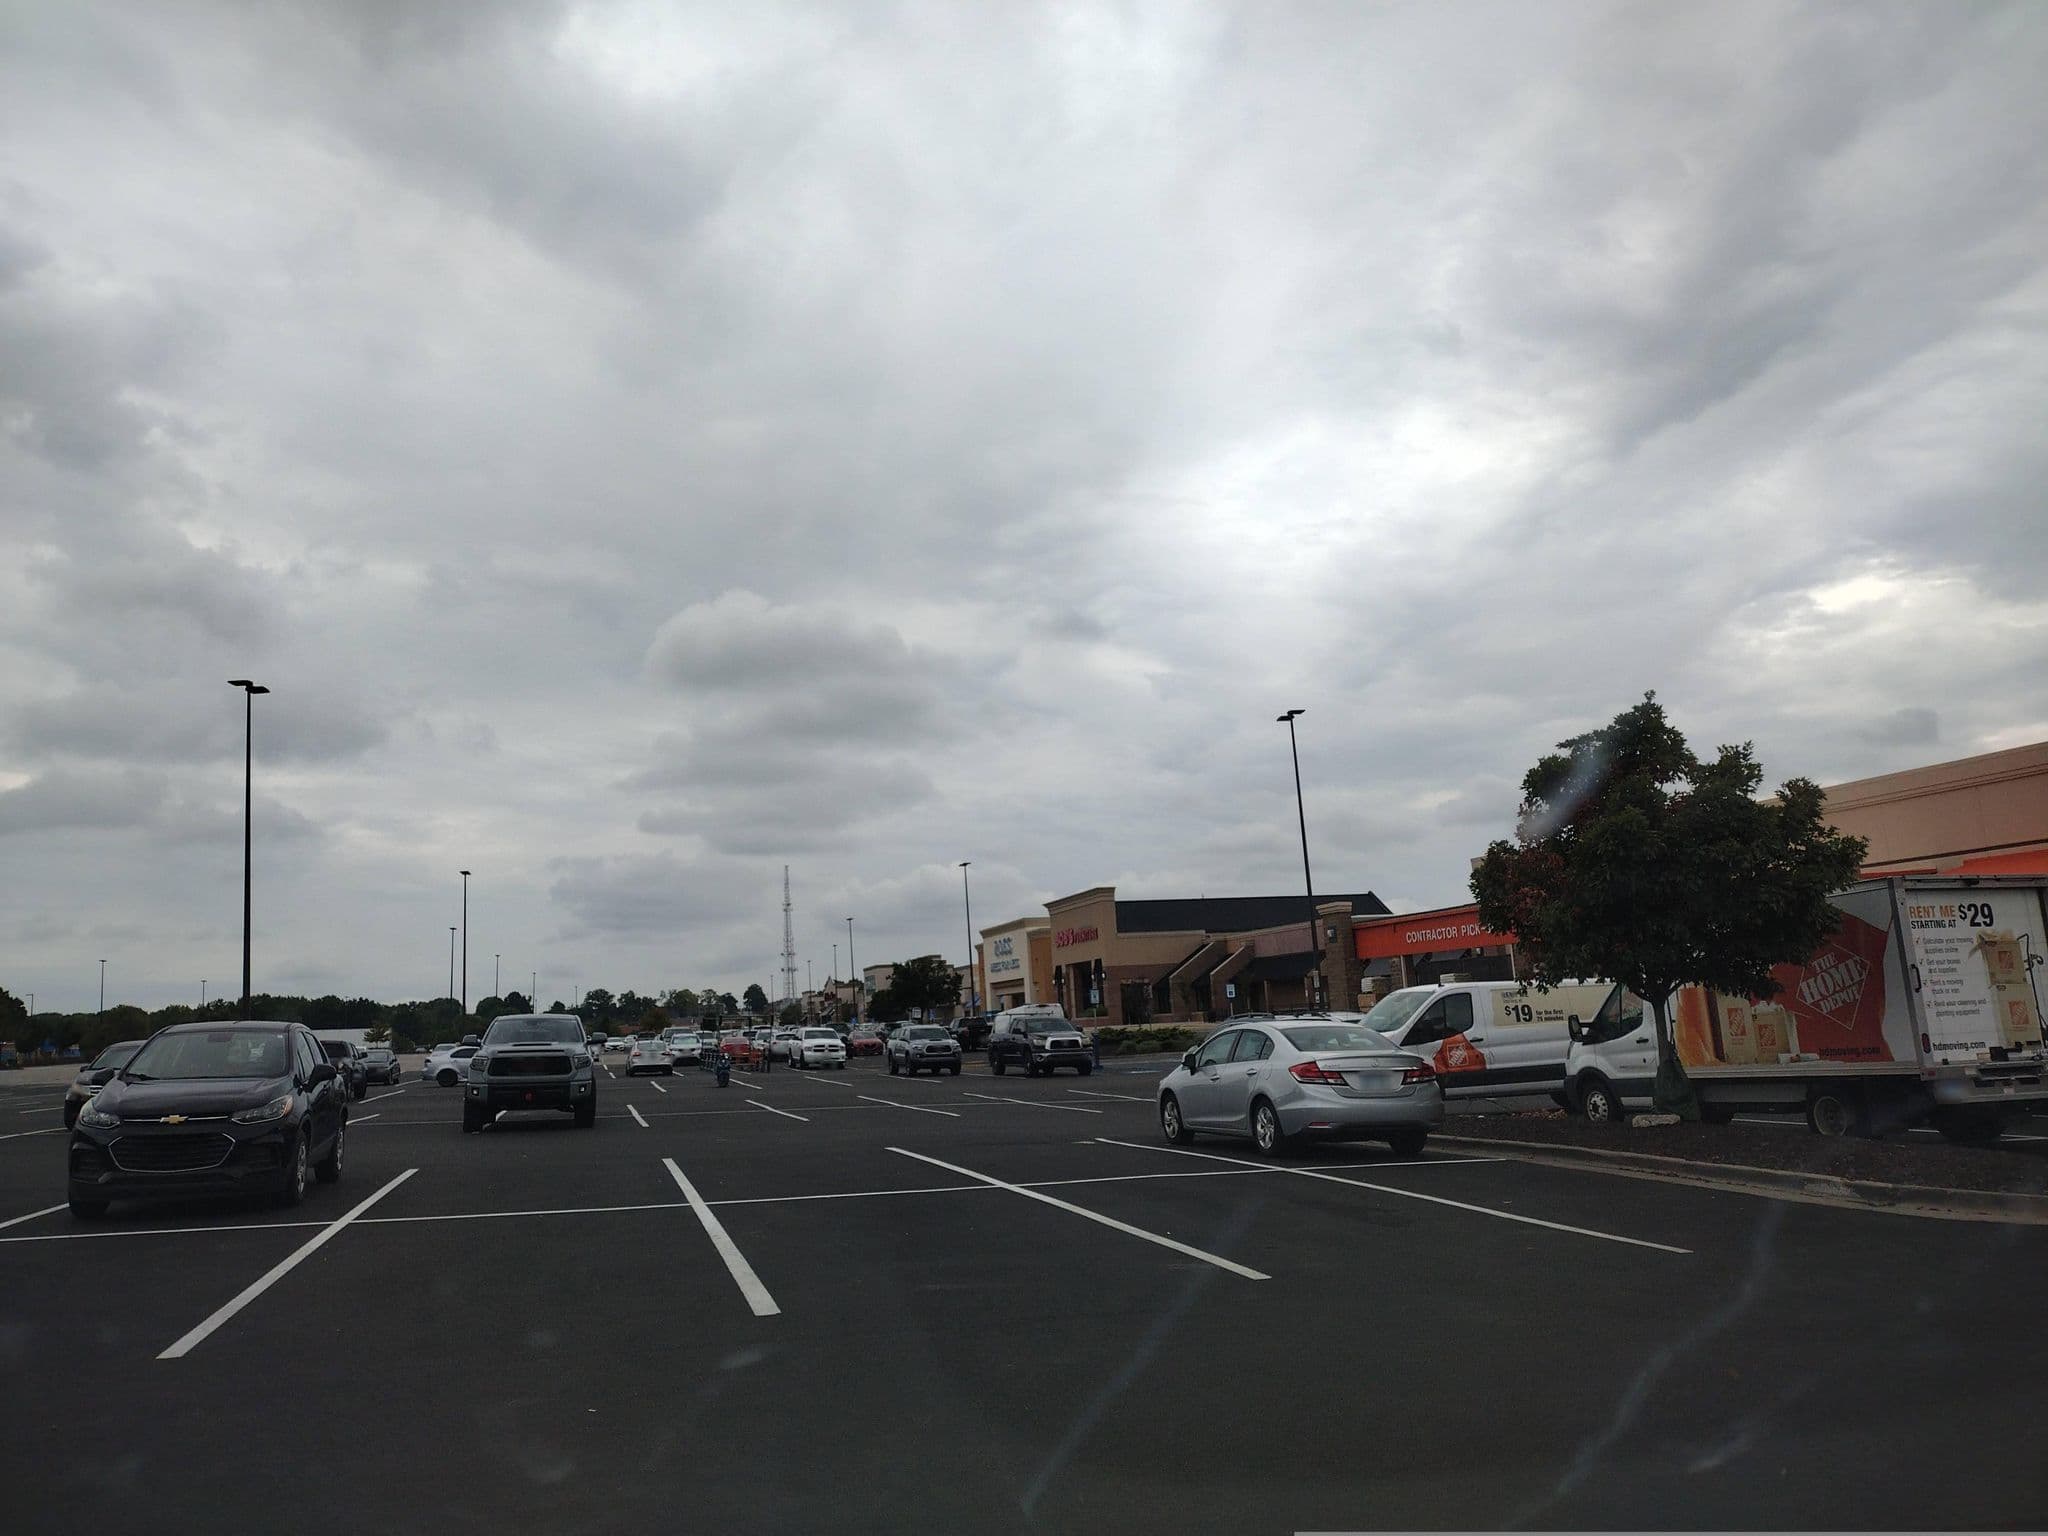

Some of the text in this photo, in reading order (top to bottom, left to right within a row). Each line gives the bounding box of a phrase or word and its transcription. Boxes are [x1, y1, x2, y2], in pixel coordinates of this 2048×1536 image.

[1909, 905, 1956, 919] RENT ME
[1958, 902, 1994, 927] $29
[1910, 919, 1957, 929] STARTING AT
[1406, 926, 1458, 943] CONTRACTOR
[1811, 952, 1839, 973] THE
[1800, 958, 1866, 1005] HOME
[1819, 983, 1861, 1014] DEPOT
[1504, 1004, 1533, 1022] $19
[1932, 1040, 1986, 1051] hdmoving.com
